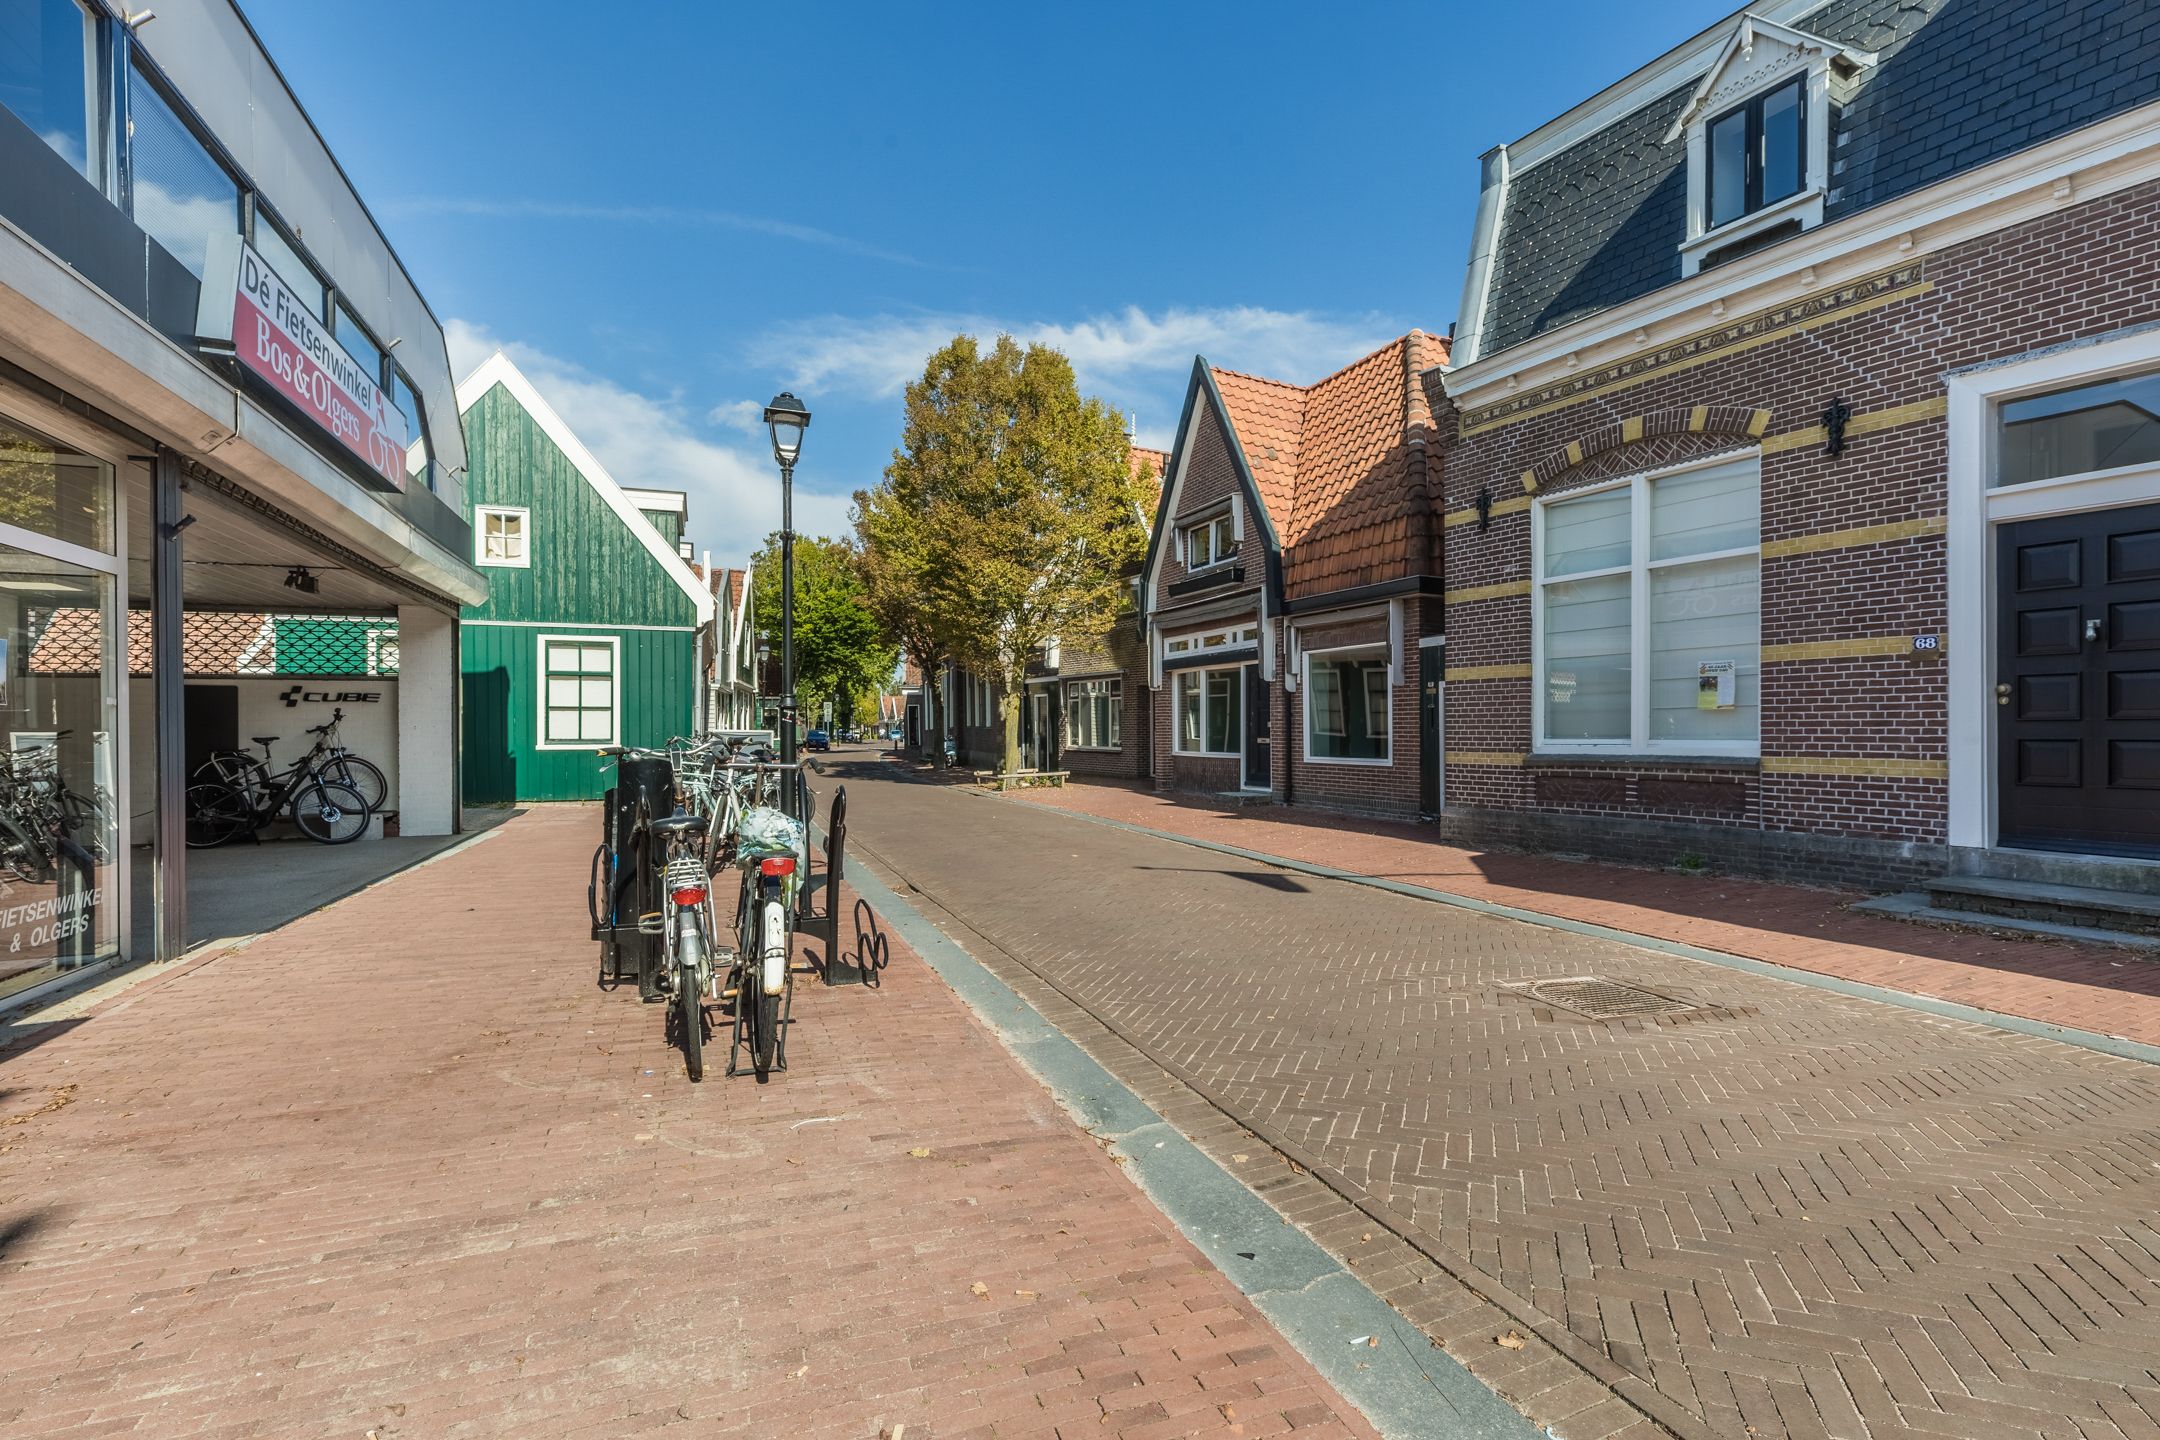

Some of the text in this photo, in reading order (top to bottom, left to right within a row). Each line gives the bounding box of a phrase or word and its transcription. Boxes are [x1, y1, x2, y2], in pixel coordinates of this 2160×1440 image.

[245, 254, 371, 410] Dé Fietsenwinkel
[1915, 637, 1937, 649] 68
[302, 691, 382, 703] CUBE
[9, 913, 90, 953] & OLGERS
